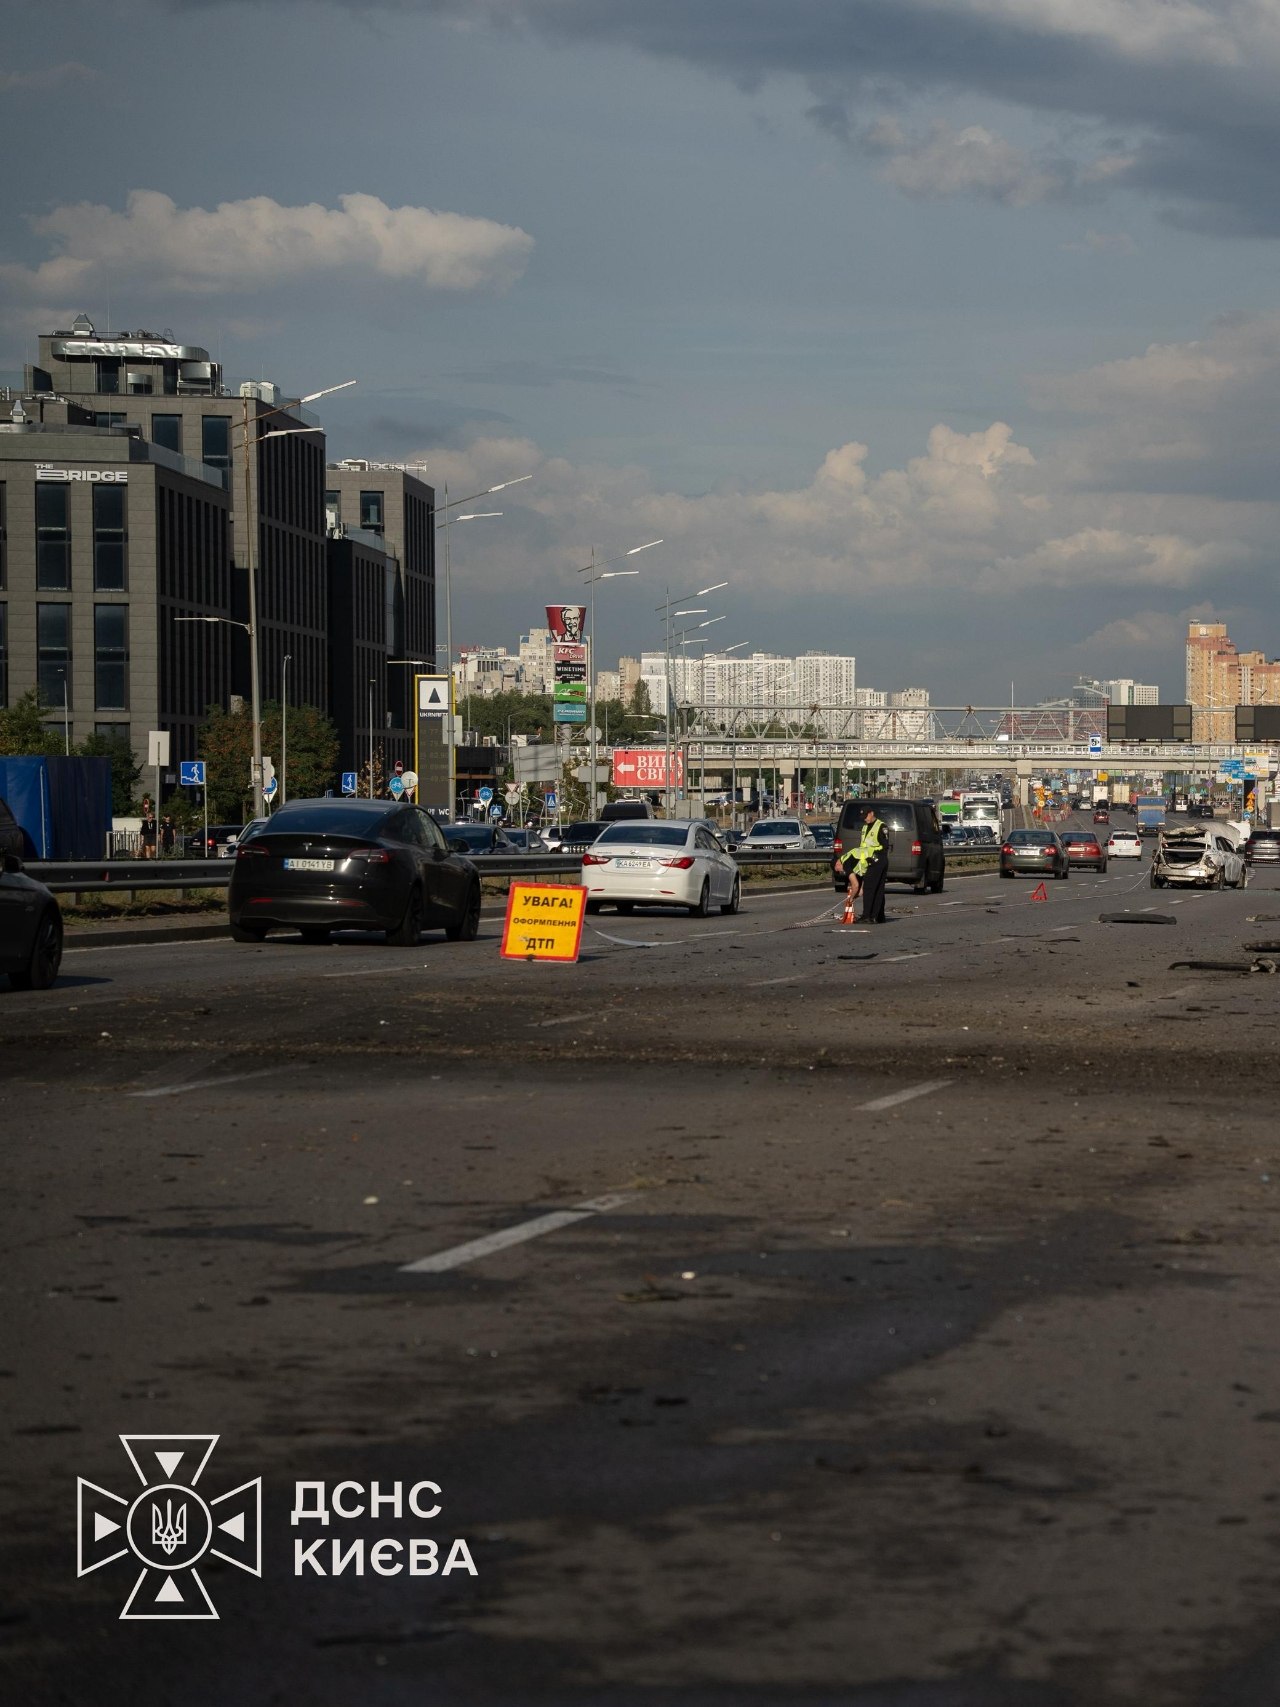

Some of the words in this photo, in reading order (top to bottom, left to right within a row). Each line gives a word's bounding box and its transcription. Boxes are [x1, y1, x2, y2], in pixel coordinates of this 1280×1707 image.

[36, 470, 128, 482] BRIDGE
[523, 896, 573, 908] УВАГА!
[525, 938, 555, 951] ДТП
